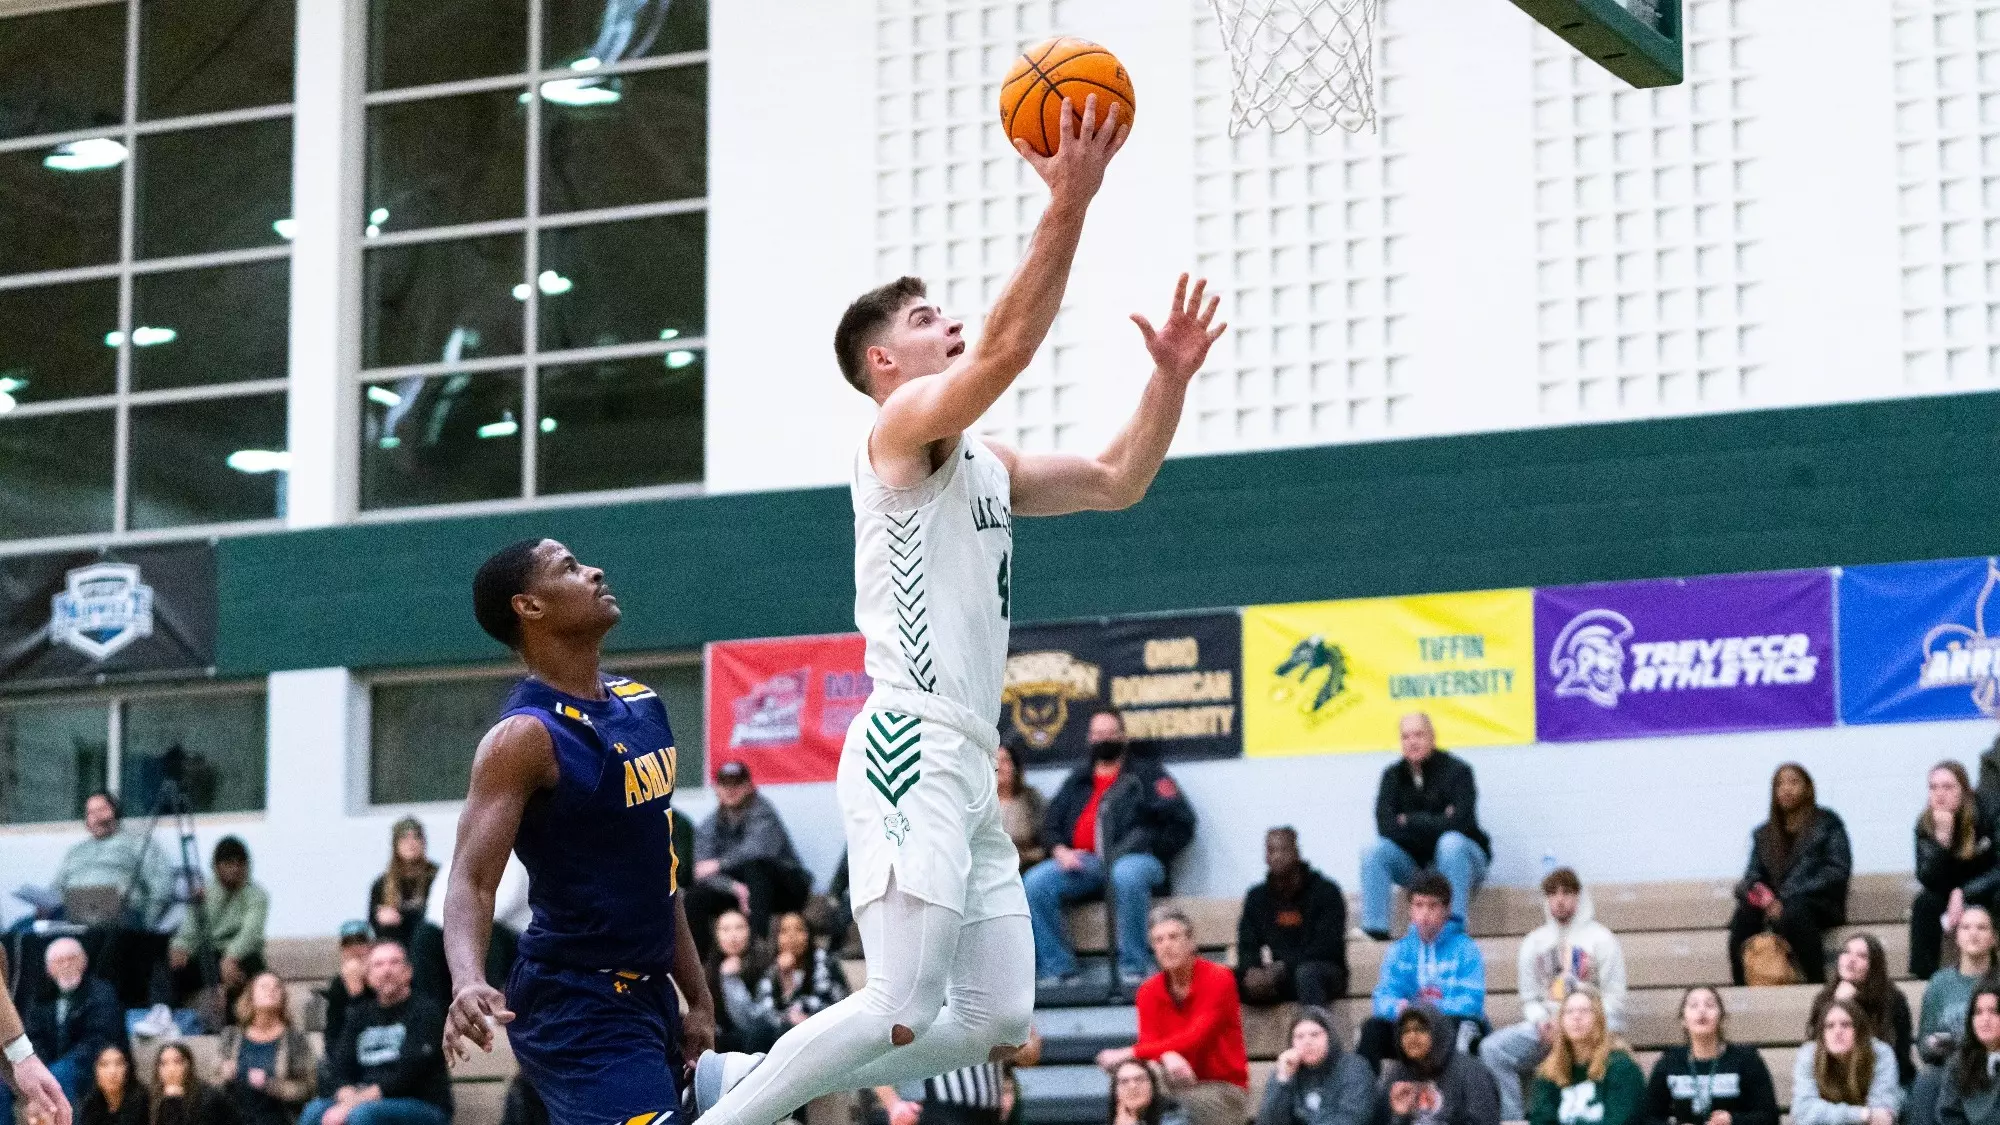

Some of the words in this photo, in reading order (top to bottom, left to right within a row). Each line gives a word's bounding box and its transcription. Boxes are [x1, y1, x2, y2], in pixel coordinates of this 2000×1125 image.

[1144, 636, 1198, 669] OHIO
[1418, 634, 1485, 662] TIFFIN
[1630, 633, 1810, 666] TREVECCA
[1111, 670, 1233, 706] DOMINICAN
[1388, 668, 1515, 699] UNIVERSITY
[1628, 656, 1818, 691] ATHLETICS
[1120, 704, 1235, 738] NIVERSITY
